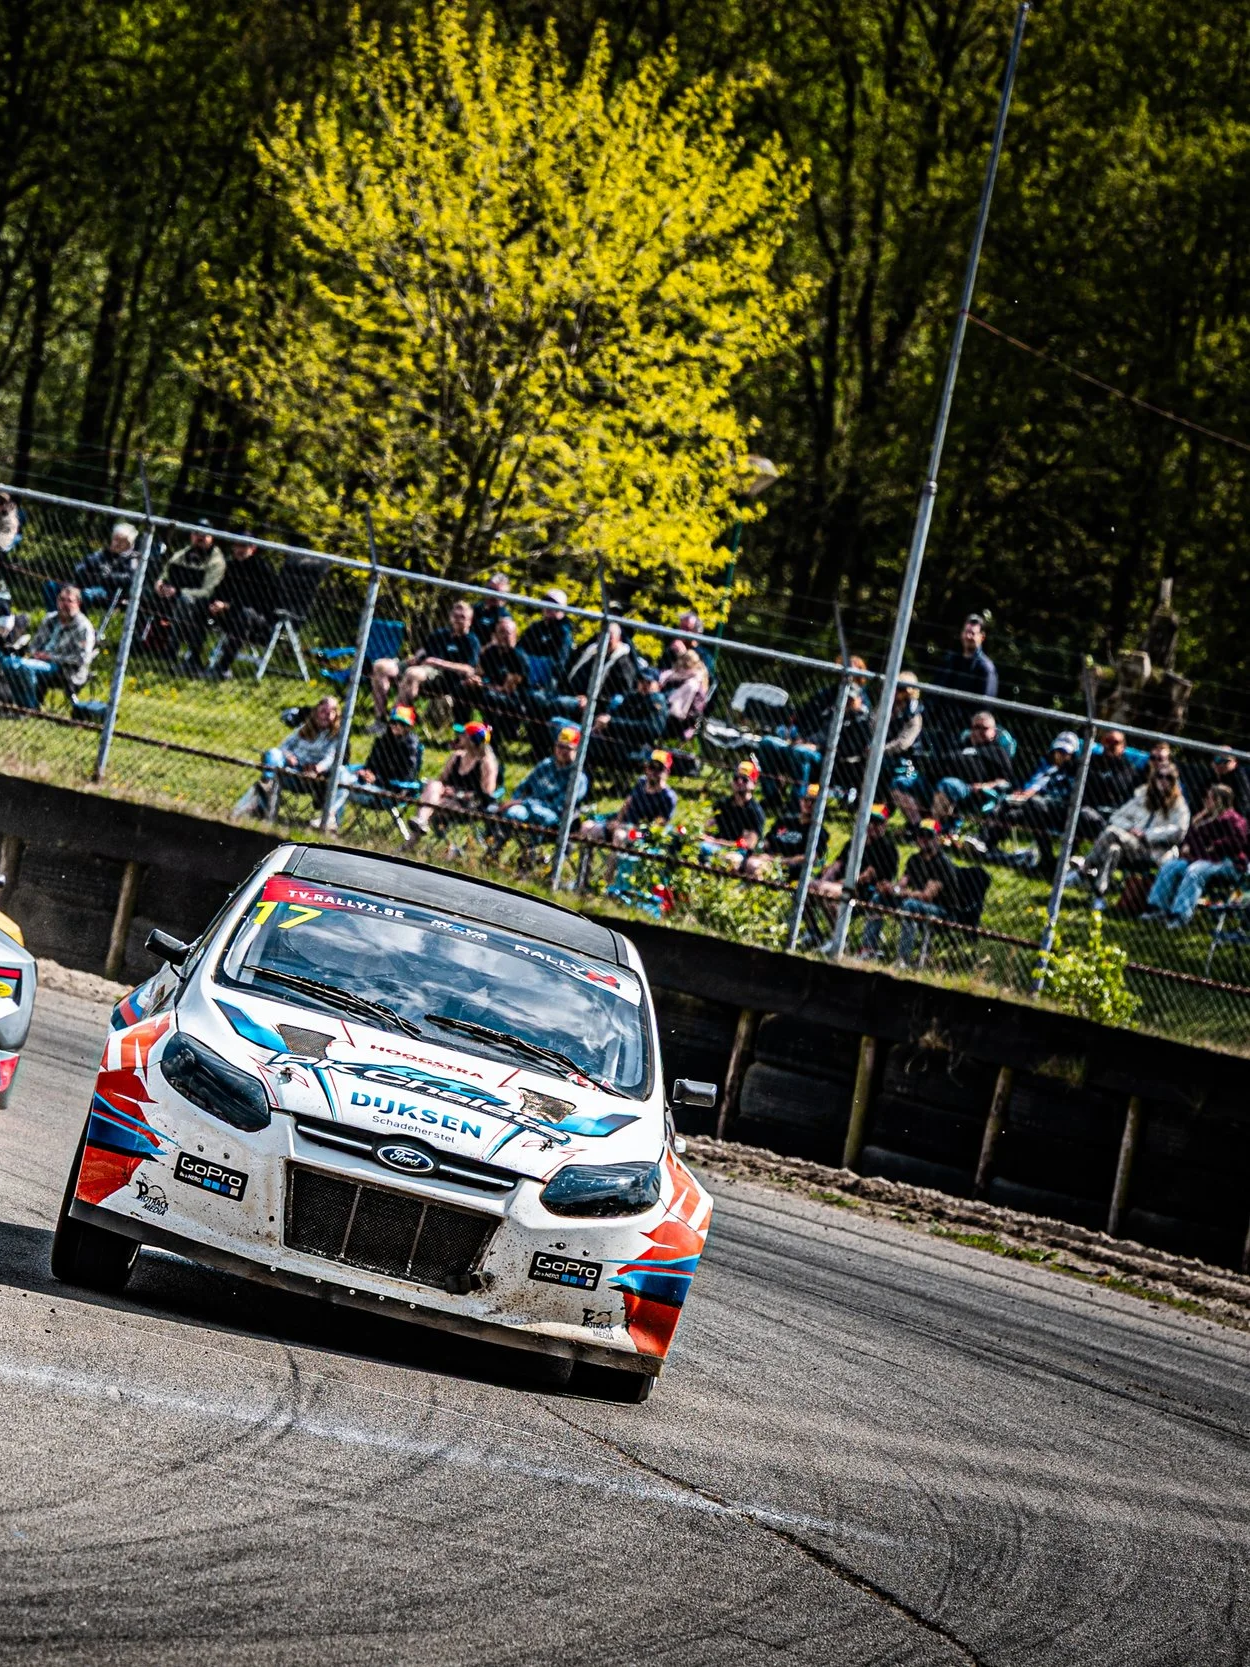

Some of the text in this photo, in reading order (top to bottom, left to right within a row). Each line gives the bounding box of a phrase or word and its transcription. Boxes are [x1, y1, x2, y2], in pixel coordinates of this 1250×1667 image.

[253, 901, 323, 929] 17
[288, 889, 406, 919] TV.RALLYX.SE
[370, 1044, 484, 1080] HOOGSTRA
[350, 1091, 482, 1139] DIJKSEN
[372, 1115, 456, 1144] Schadeherstel
[180, 1157, 242, 1187] GoPro
[389, 1148, 420, 1168] Ford
[143, 1202, 166, 1217] MEDIA
[536, 1256, 598, 1278] GoPro
